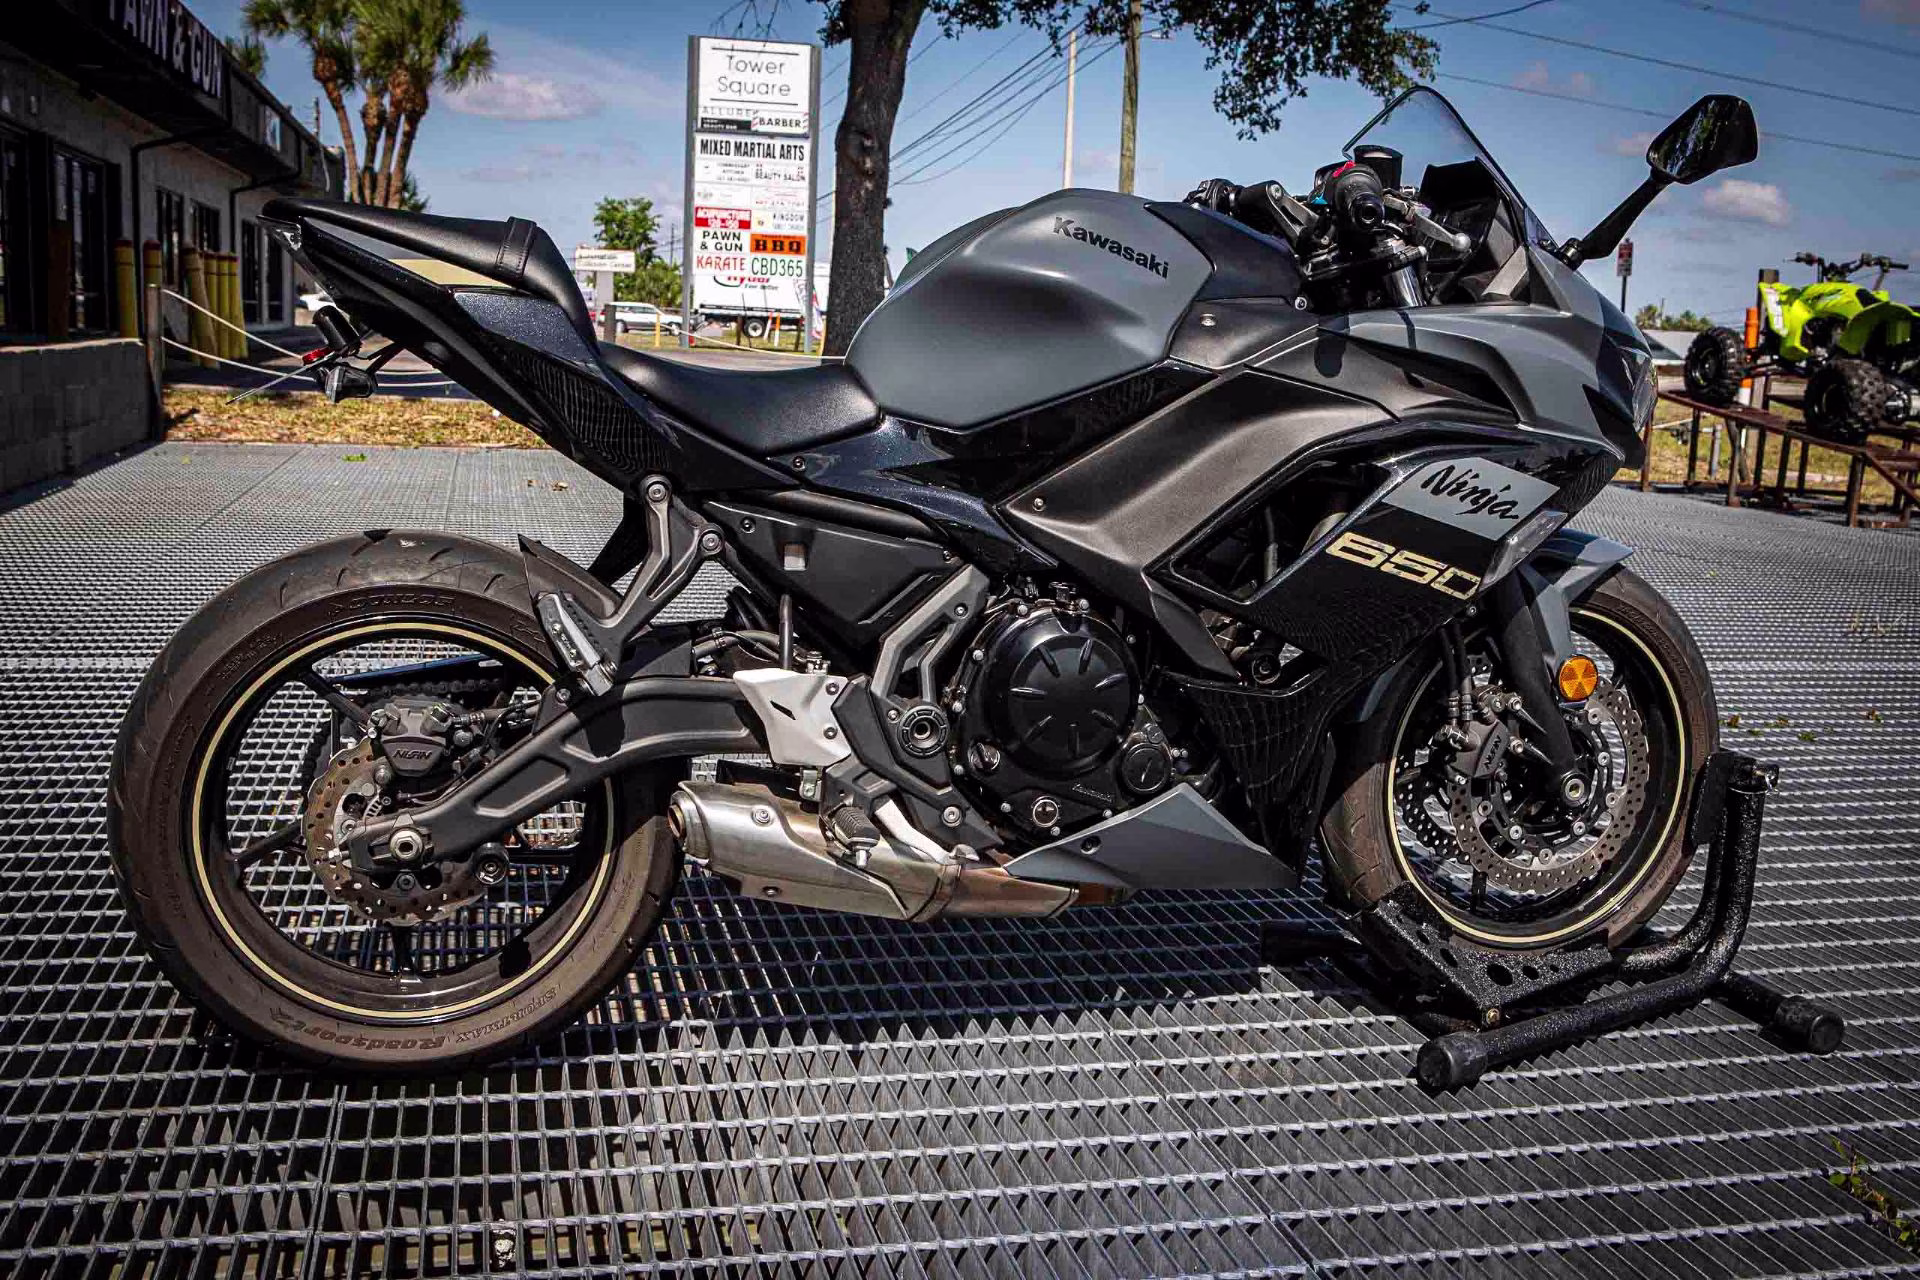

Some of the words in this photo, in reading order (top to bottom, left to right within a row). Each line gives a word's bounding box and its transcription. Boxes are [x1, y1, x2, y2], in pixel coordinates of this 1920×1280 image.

[109, 0, 168, 61] AWN
[191, 22, 223, 98] GUN
[726, 54, 785, 75] Tower
[717, 75, 791, 97] Square
[759, 117, 801, 128] BARBER
[700, 138, 731, 156] MIXED
[734, 140, 776, 160] MARTIAL
[779, 143, 805, 161] ARTS
[755, 171, 781, 181] BEAUTY
[783, 172, 806, 182] SALON
[702, 230, 741, 241] PAWN
[700, 241, 708, 250] &
[714, 242, 743, 252] GUN
[754, 239, 802, 254] BBQ
[1052, 216, 1169, 279] Kawasaki
[696, 255, 747, 271] KARATE
[751, 257, 803, 278] CBD365
[1420, 464, 1519, 520] Ninja
[1325, 532, 1482, 601] 650
